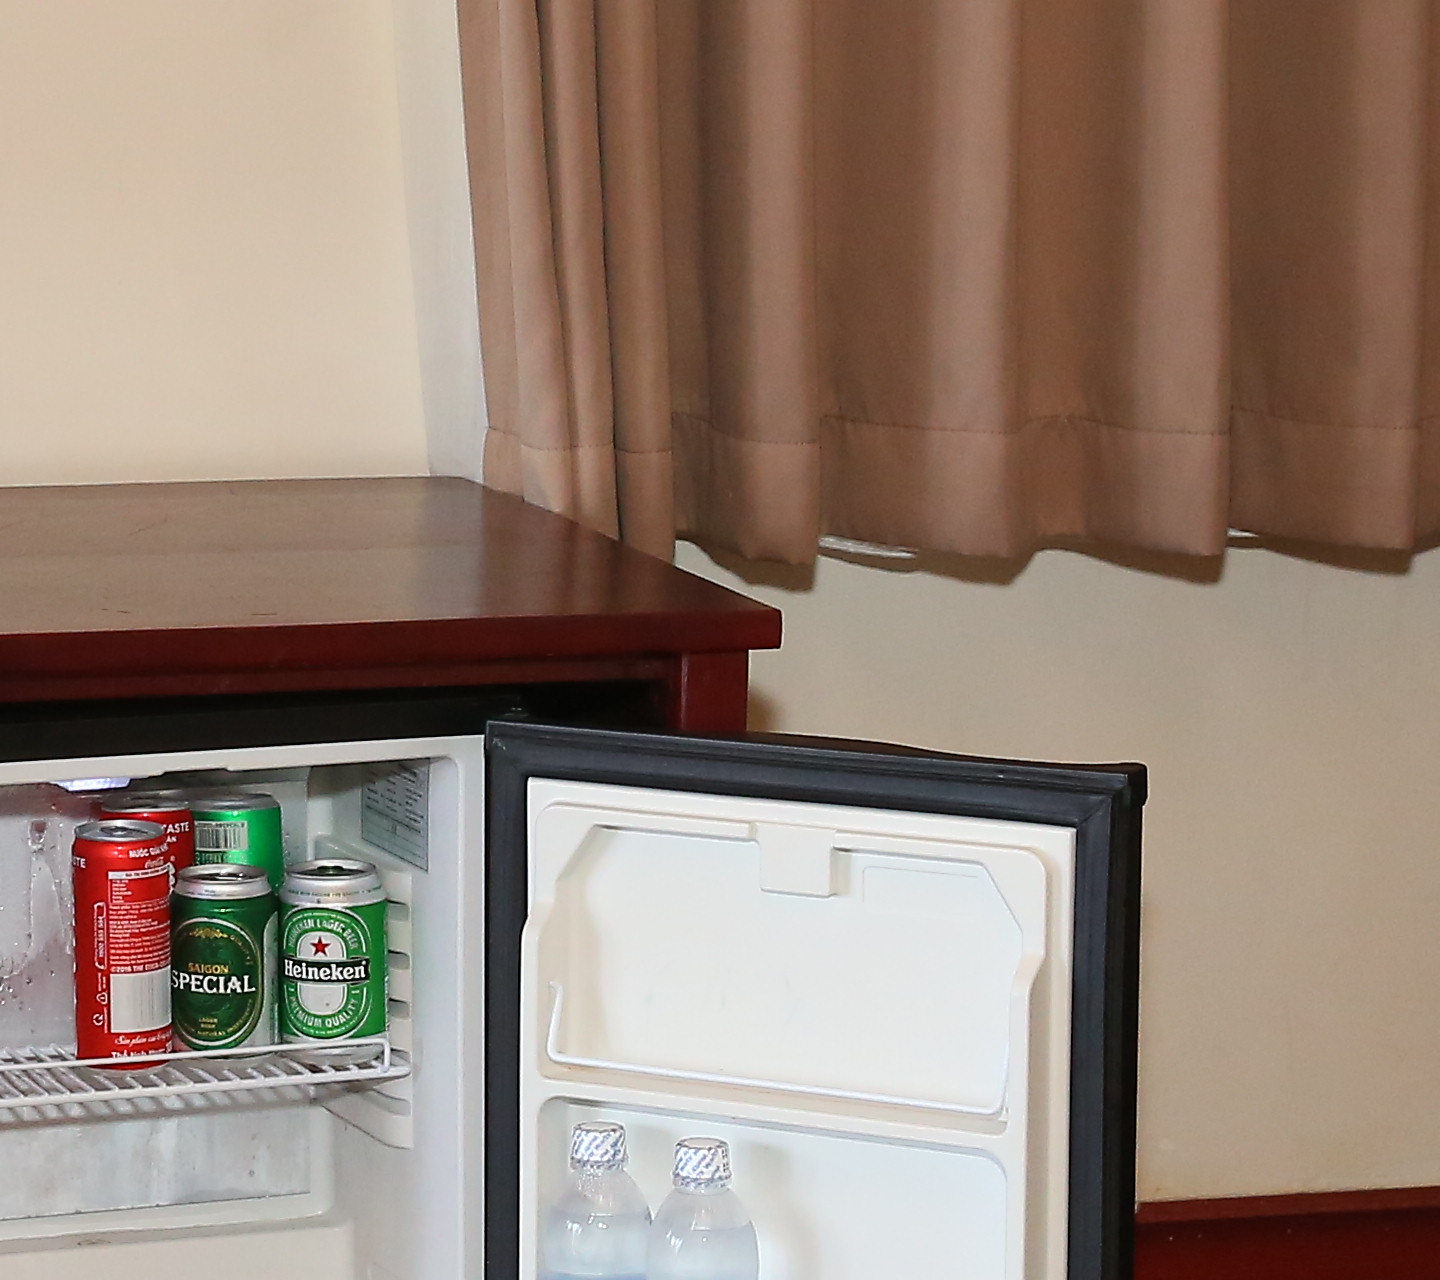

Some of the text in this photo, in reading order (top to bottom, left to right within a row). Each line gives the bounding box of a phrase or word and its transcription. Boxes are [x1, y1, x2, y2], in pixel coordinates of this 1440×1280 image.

[188, 963, 229, 974] SAIGON
[284, 959, 366, 981] Heineken
[171, 970, 256, 994] SPECIAL
[288, 996, 323, 1028] PREMIUM
[325, 998, 359, 1028] QUALITY
